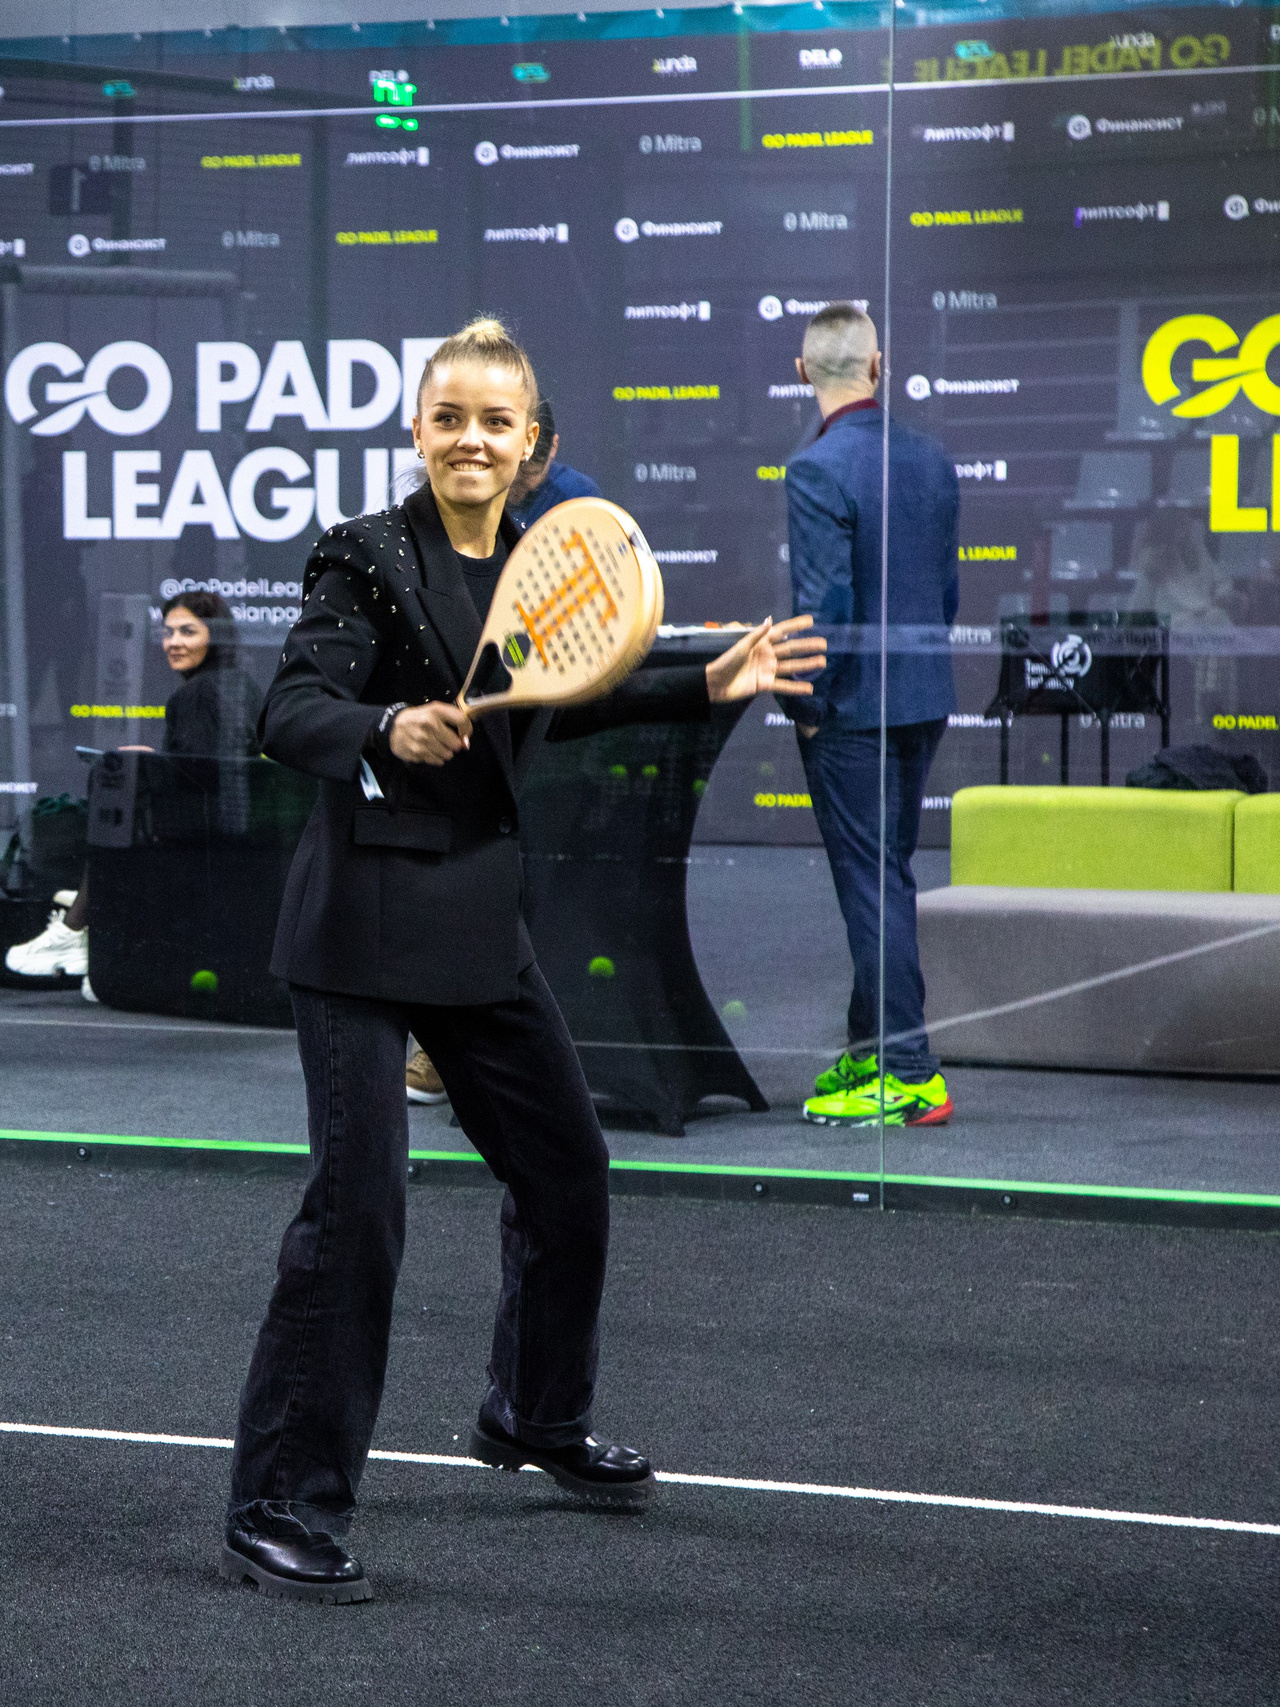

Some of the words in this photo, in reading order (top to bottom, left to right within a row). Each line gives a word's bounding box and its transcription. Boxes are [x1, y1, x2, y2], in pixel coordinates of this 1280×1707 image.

[799, 211, 848, 231] Mitra
[947, 290, 998, 310] Mitra
[4, 340, 173, 437] GO
[650, 463, 697, 482] Mitra
[1214, 715, 1236, 730] GO
